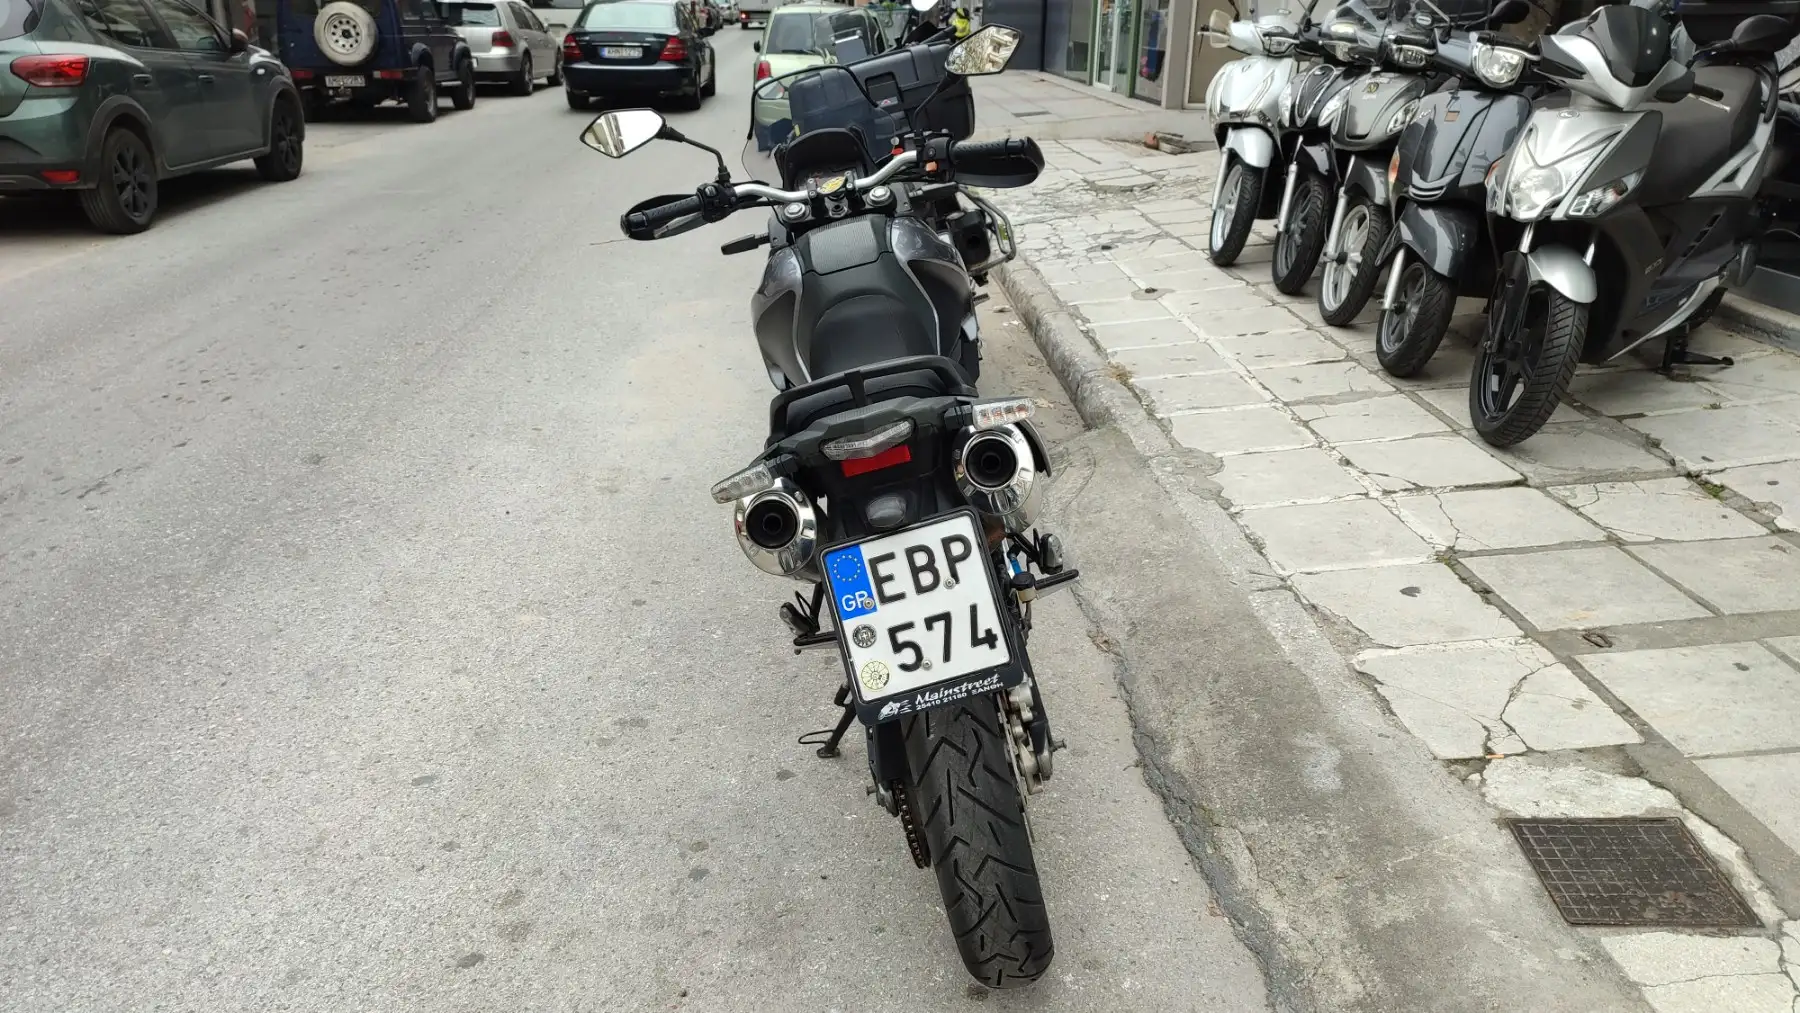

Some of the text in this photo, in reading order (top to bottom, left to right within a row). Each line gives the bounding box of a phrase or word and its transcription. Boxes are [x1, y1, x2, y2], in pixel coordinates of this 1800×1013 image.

[868, 534, 972, 606] EBP
[887, 603, 998, 672] 574
[915, 673, 1000, 705] Mainstreet
[915, 699, 940, 711] 25410
